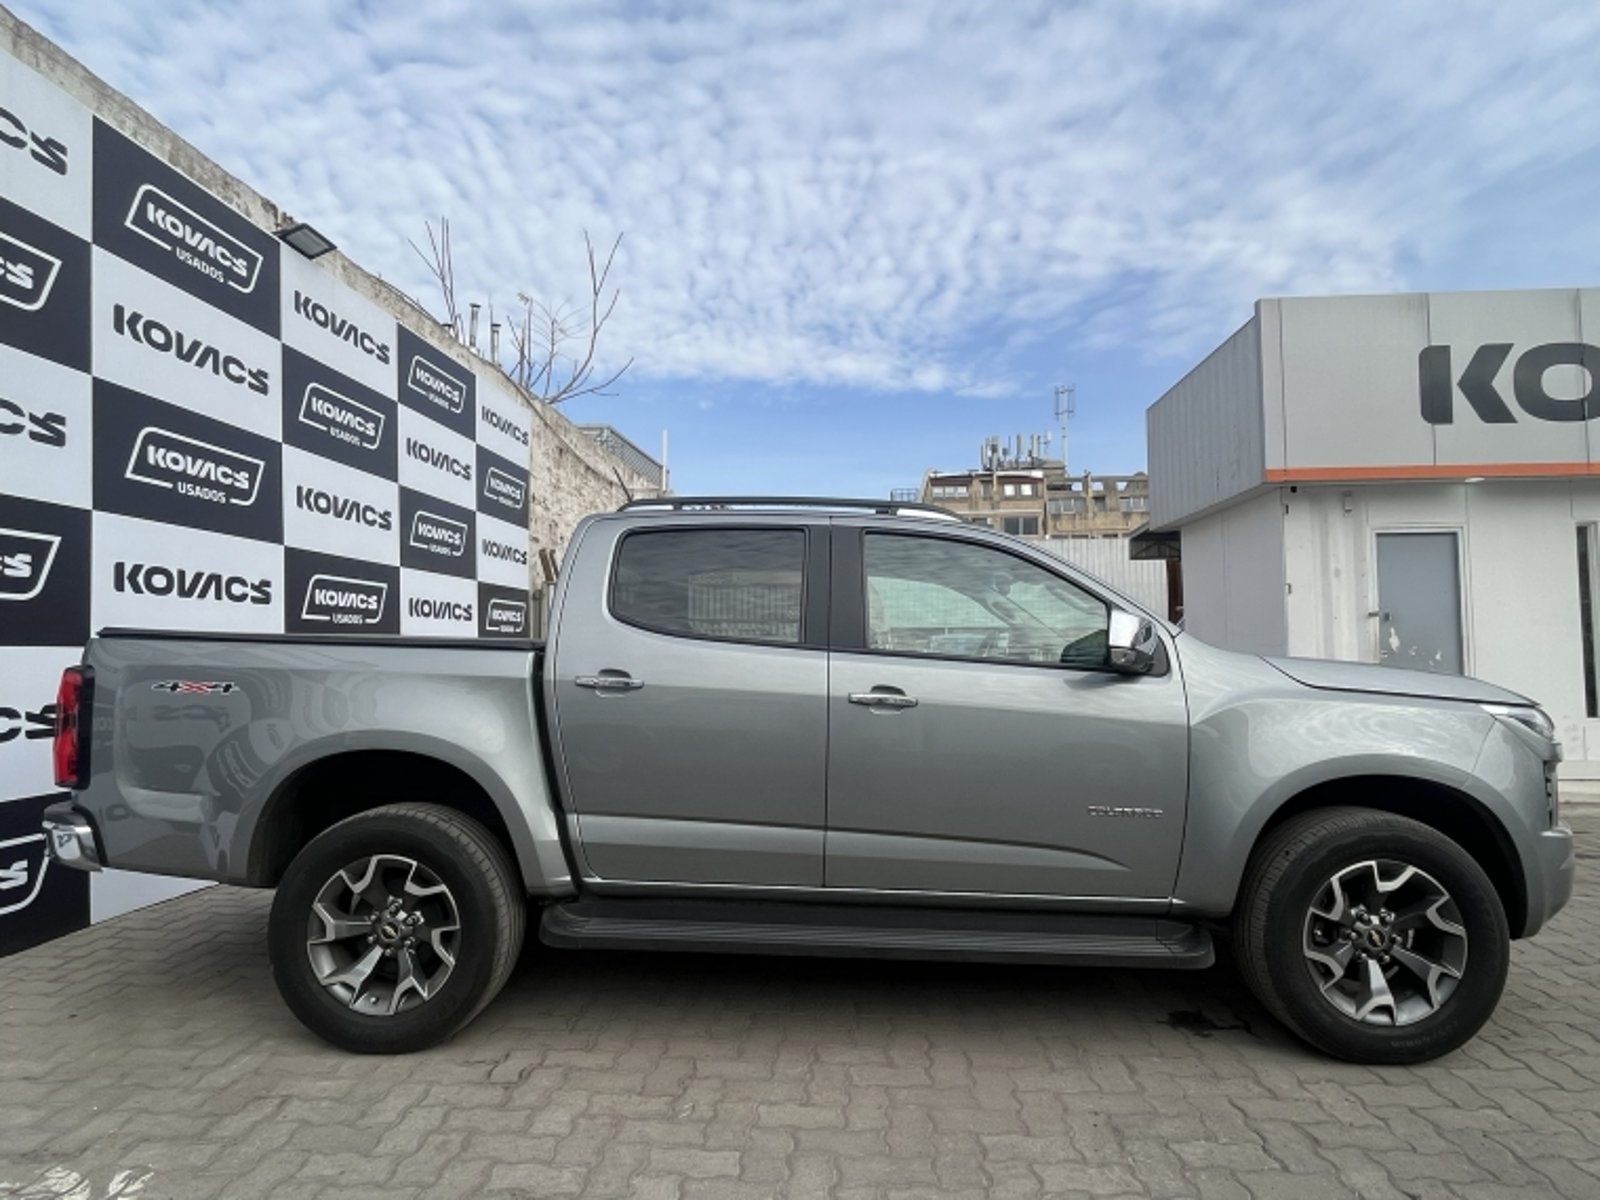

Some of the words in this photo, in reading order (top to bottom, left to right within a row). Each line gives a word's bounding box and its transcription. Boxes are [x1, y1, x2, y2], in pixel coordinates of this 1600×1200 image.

[146, 202, 248, 277] KOVACS
[0, 256, 34, 290] S
[176, 247, 225, 283] USADOS
[294, 290, 390, 364] KOVACS
[113, 303, 269, 396] KOVACS
[416, 367, 460, 403] KOVACS
[1419, 342, 1600, 424] KO
[312, 396, 376, 437] KOVACS
[482, 405, 528, 447] KOVACS
[330, 426, 361, 447] USADOS
[147, 444, 249, 489] KOVACS
[406, 437, 471, 480] KOVACS
[177, 481, 226, 504] USADOS
[296, 485, 392, 531] KOVACS
[418, 522, 461, 545] KOVACS
[0, 553, 32, 578] S
[482, 539, 527, 565] KOVACS
[114, 561, 271, 604] KOVACS
[315, 588, 378, 610] KOVACS
[332, 611, 363, 624] USADOS
[409, 598, 472, 621] KOVACS
